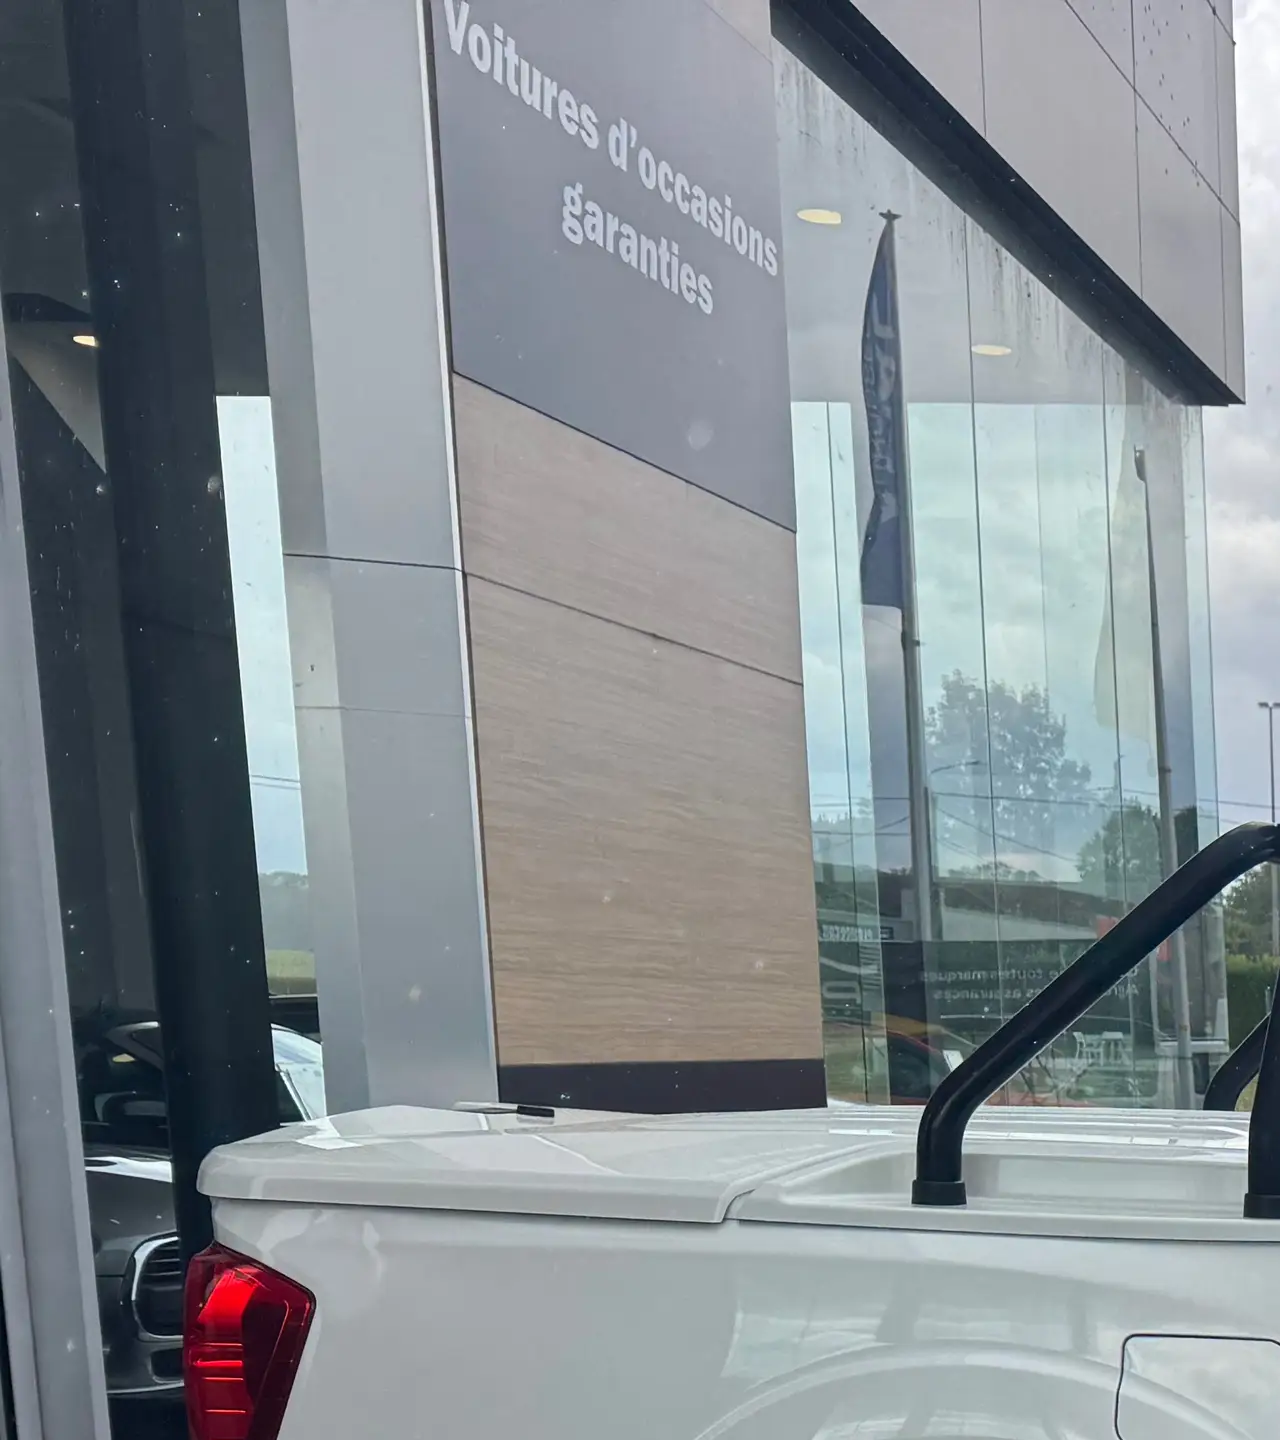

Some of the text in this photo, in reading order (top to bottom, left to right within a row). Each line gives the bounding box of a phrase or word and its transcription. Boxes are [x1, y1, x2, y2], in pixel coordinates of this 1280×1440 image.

[443, 0, 779, 277] Voitures d'occasions
[561, 182, 715, 315] garanties
